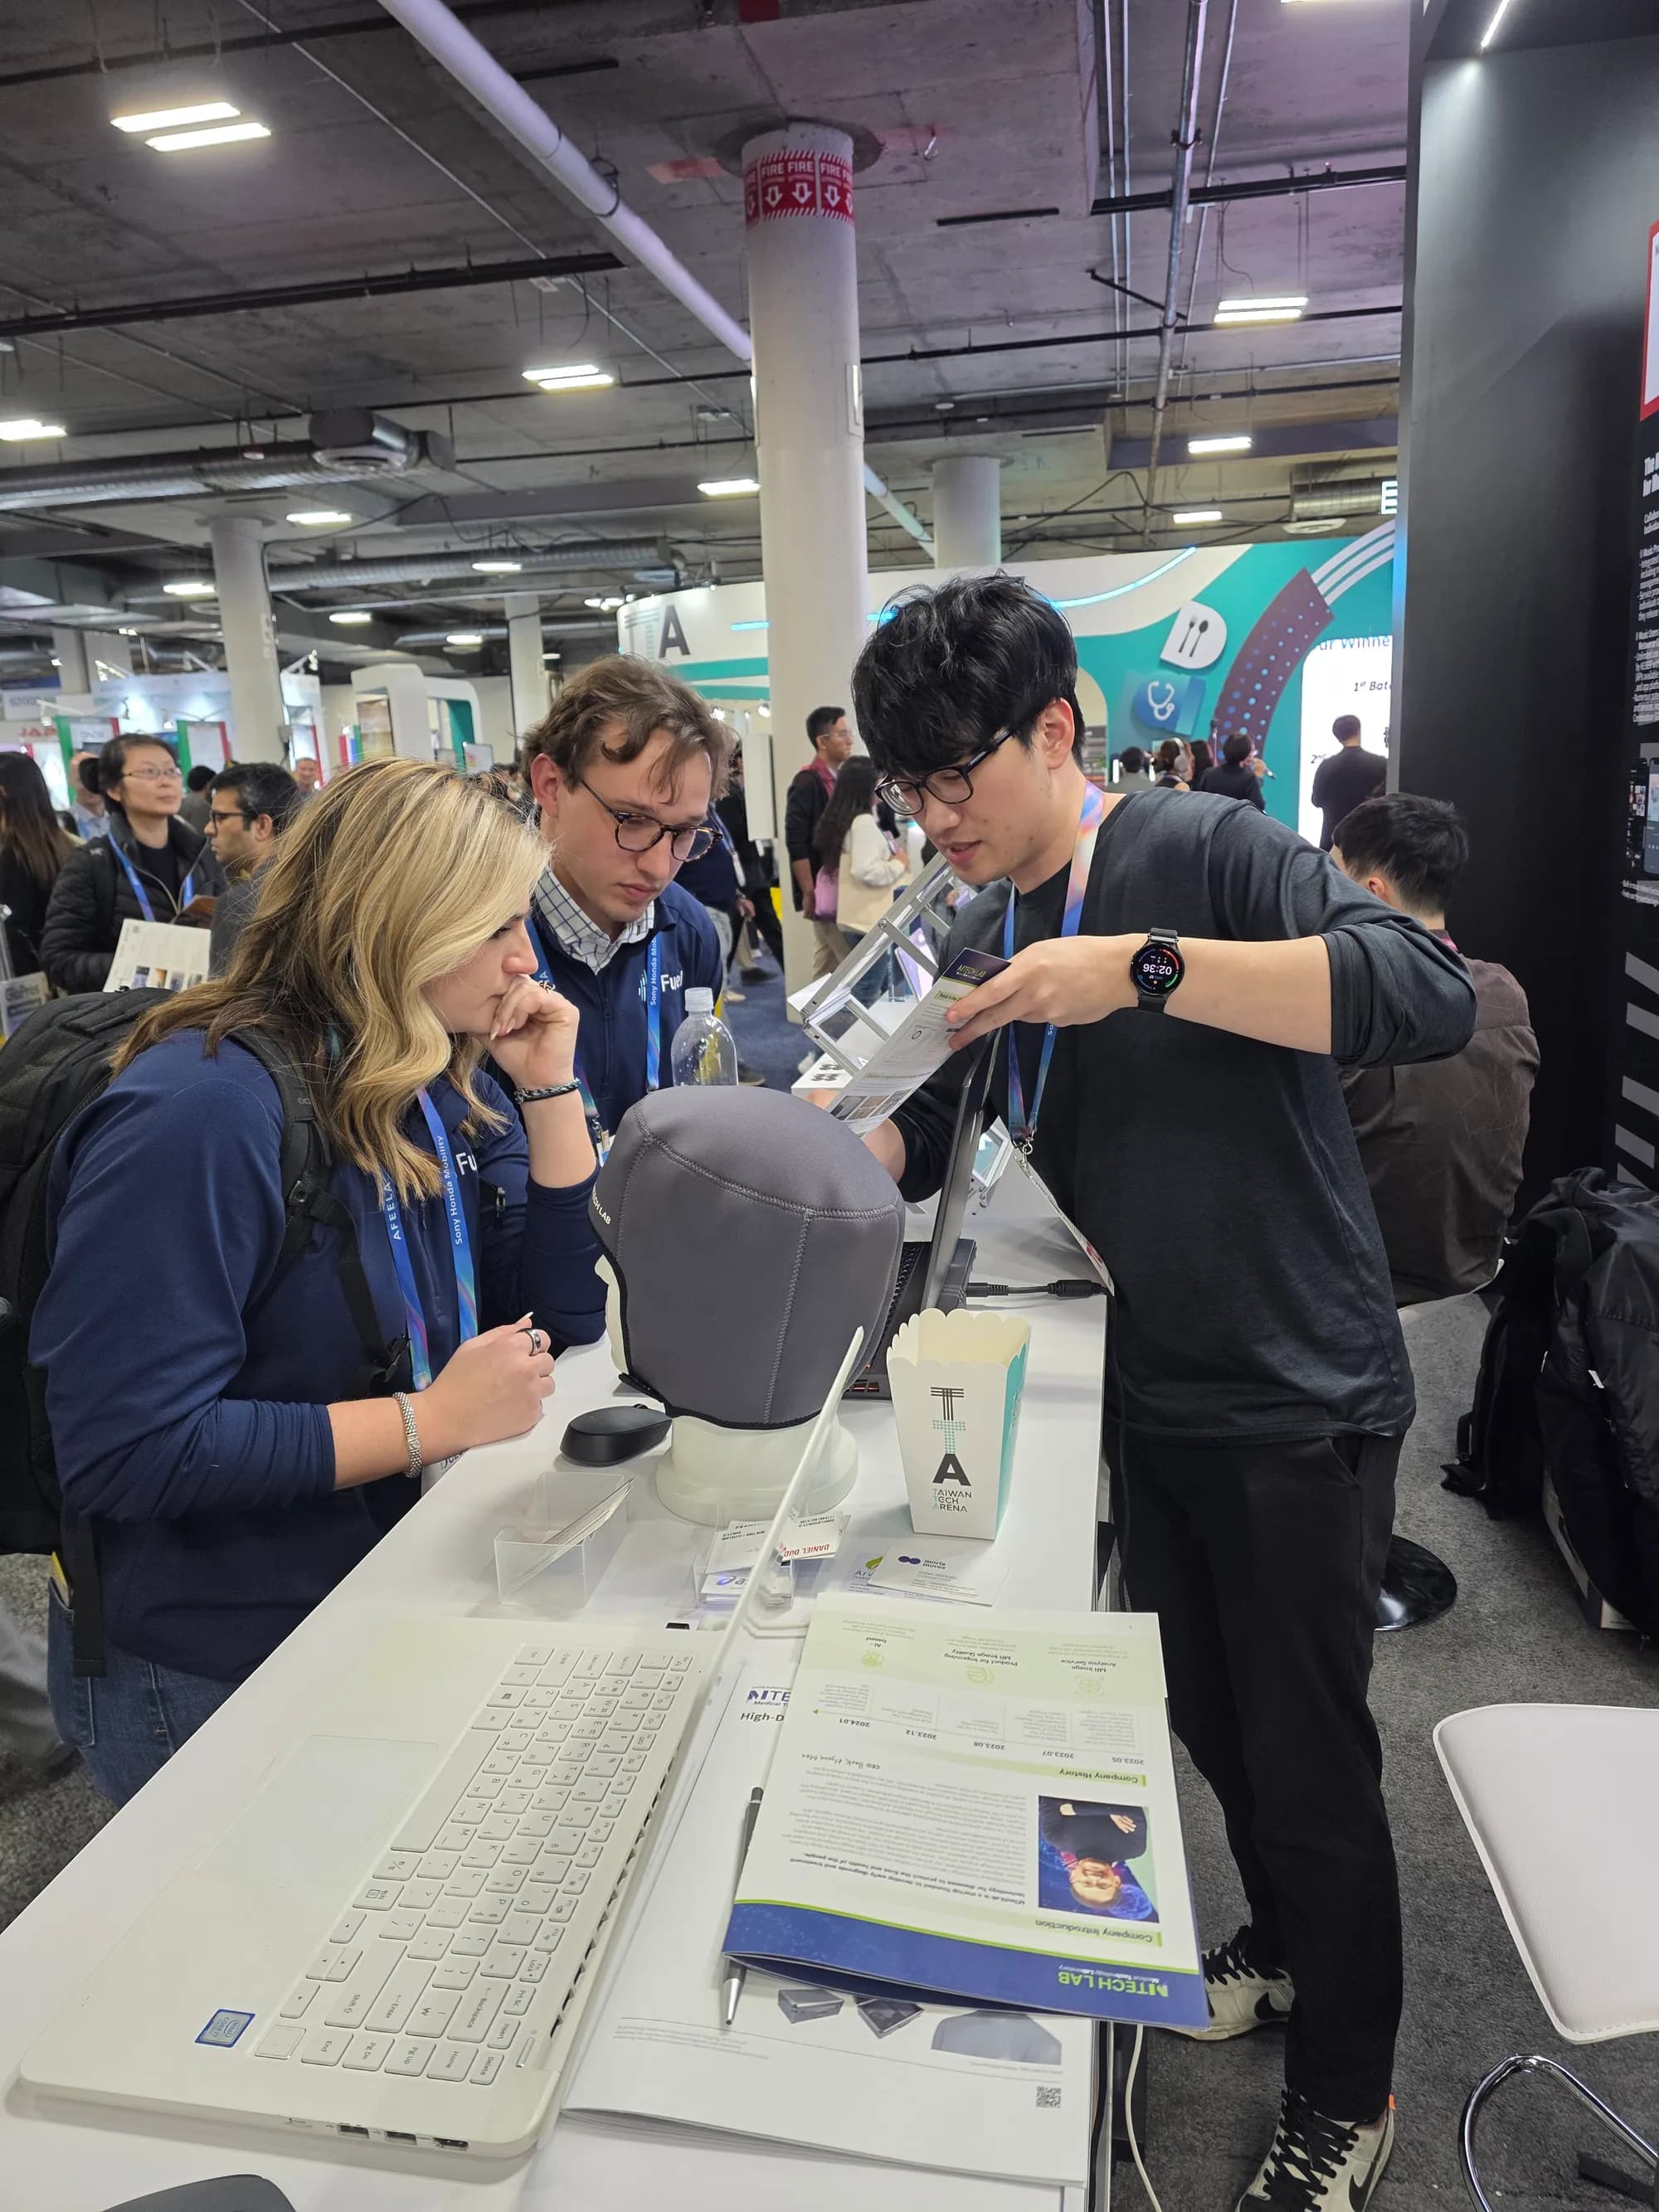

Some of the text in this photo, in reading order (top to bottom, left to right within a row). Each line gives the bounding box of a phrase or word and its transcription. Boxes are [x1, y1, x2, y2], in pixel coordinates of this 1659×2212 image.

[761, 162, 785, 177] FIRE
[788, 160, 814, 173] FIRE
[820, 162, 841, 176] FIRE
[1142, 963, 1173, 975] 02:36
[660, 970, 684, 993] Fuel
[437, 1135, 463, 1245] Sony Honda Mobility
[384, 1181, 401, 1242] AFEELA
[598, 1207, 611, 1225] LAB
[932, 1489, 972, 1500] TAIWAN
[932, 1503, 968, 1513] ARENA
[803, 1544, 830, 1553] DANIEL
[944, 1653, 978, 1663] Improving
[952, 1649, 975, 1657] Quality
[740, 1712, 785, 1722] High-D
[839, 1718, 870, 1728] 2024.01
[906, 1729, 937, 1740] 2023.12
[1112, 1757, 1145, 1765] 2023.05
[1059, 1768, 1138, 1783] Company History
[1035, 1919, 1153, 1943] Company Introduction
[1058, 1971, 1094, 1988] LAB
[348, 1994, 361, 2007] Shift
[517, 1991, 525, 1999] Prt
[385, 2003, 398, 2019] Enter
[466, 1997, 488, 2029] Backspace
[498, 2023, 510, 2039] Insert
[321, 2040, 332, 2052] End
[362, 2042, 376, 2060] Pg Dn
[403, 2047, 419, 2064] Pg Up
[445, 2051, 459, 2069] Home
[479, 2056, 494, 2076] Delete
